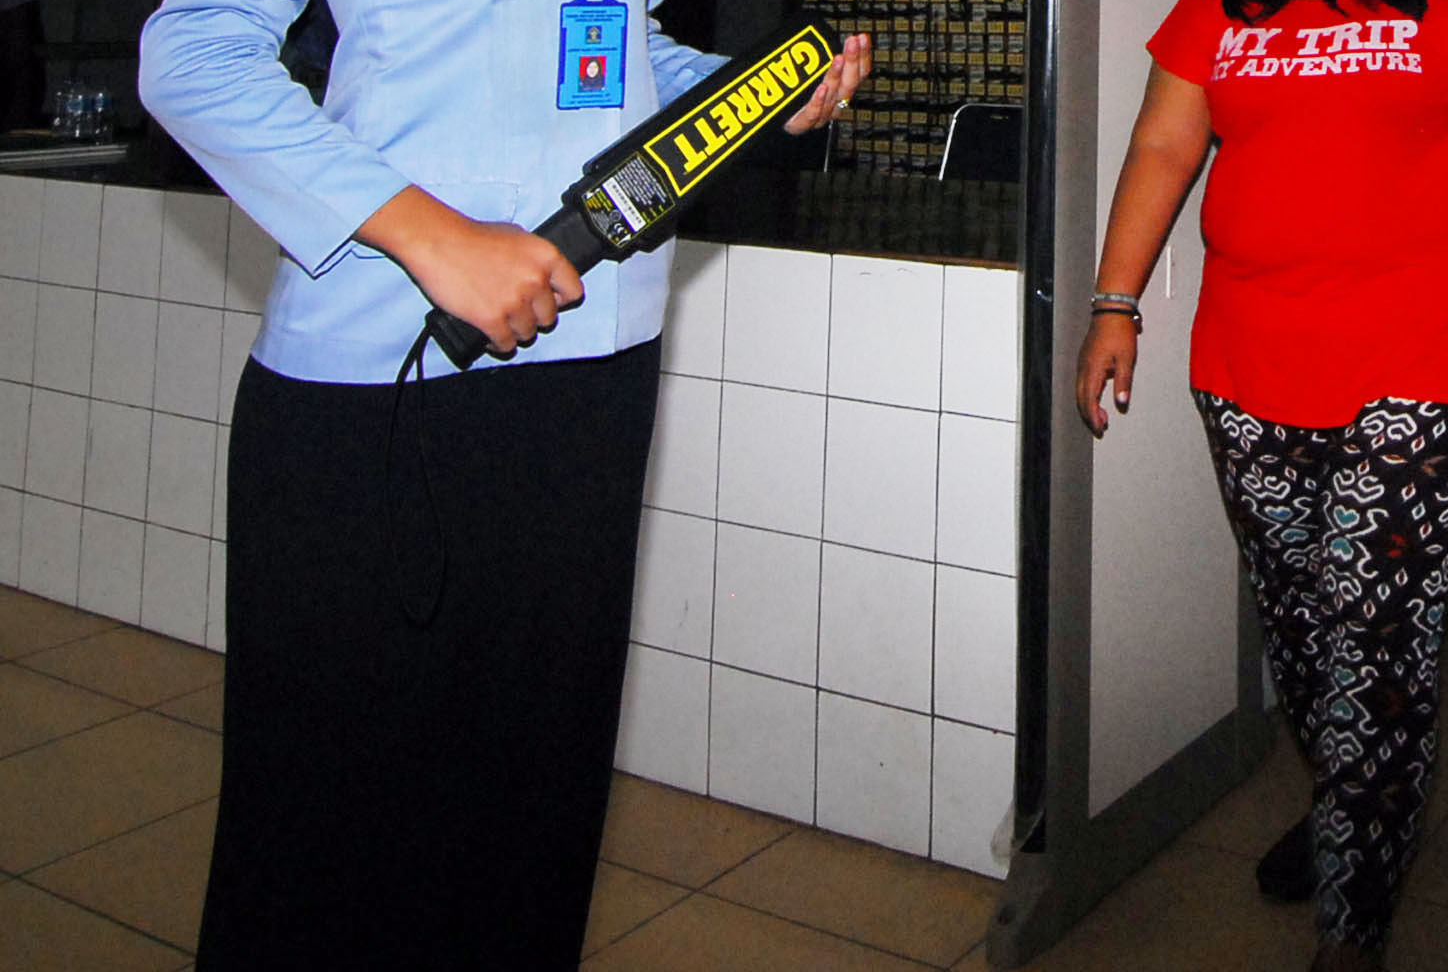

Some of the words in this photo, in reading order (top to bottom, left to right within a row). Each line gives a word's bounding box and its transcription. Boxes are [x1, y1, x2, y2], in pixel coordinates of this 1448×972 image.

[1216, 27, 1282, 60] MY
[1296, 19, 1419, 55] TRIP
[1236, 52, 1423, 76] ADVENTURE
[672, 40, 820, 176] GARRETT
